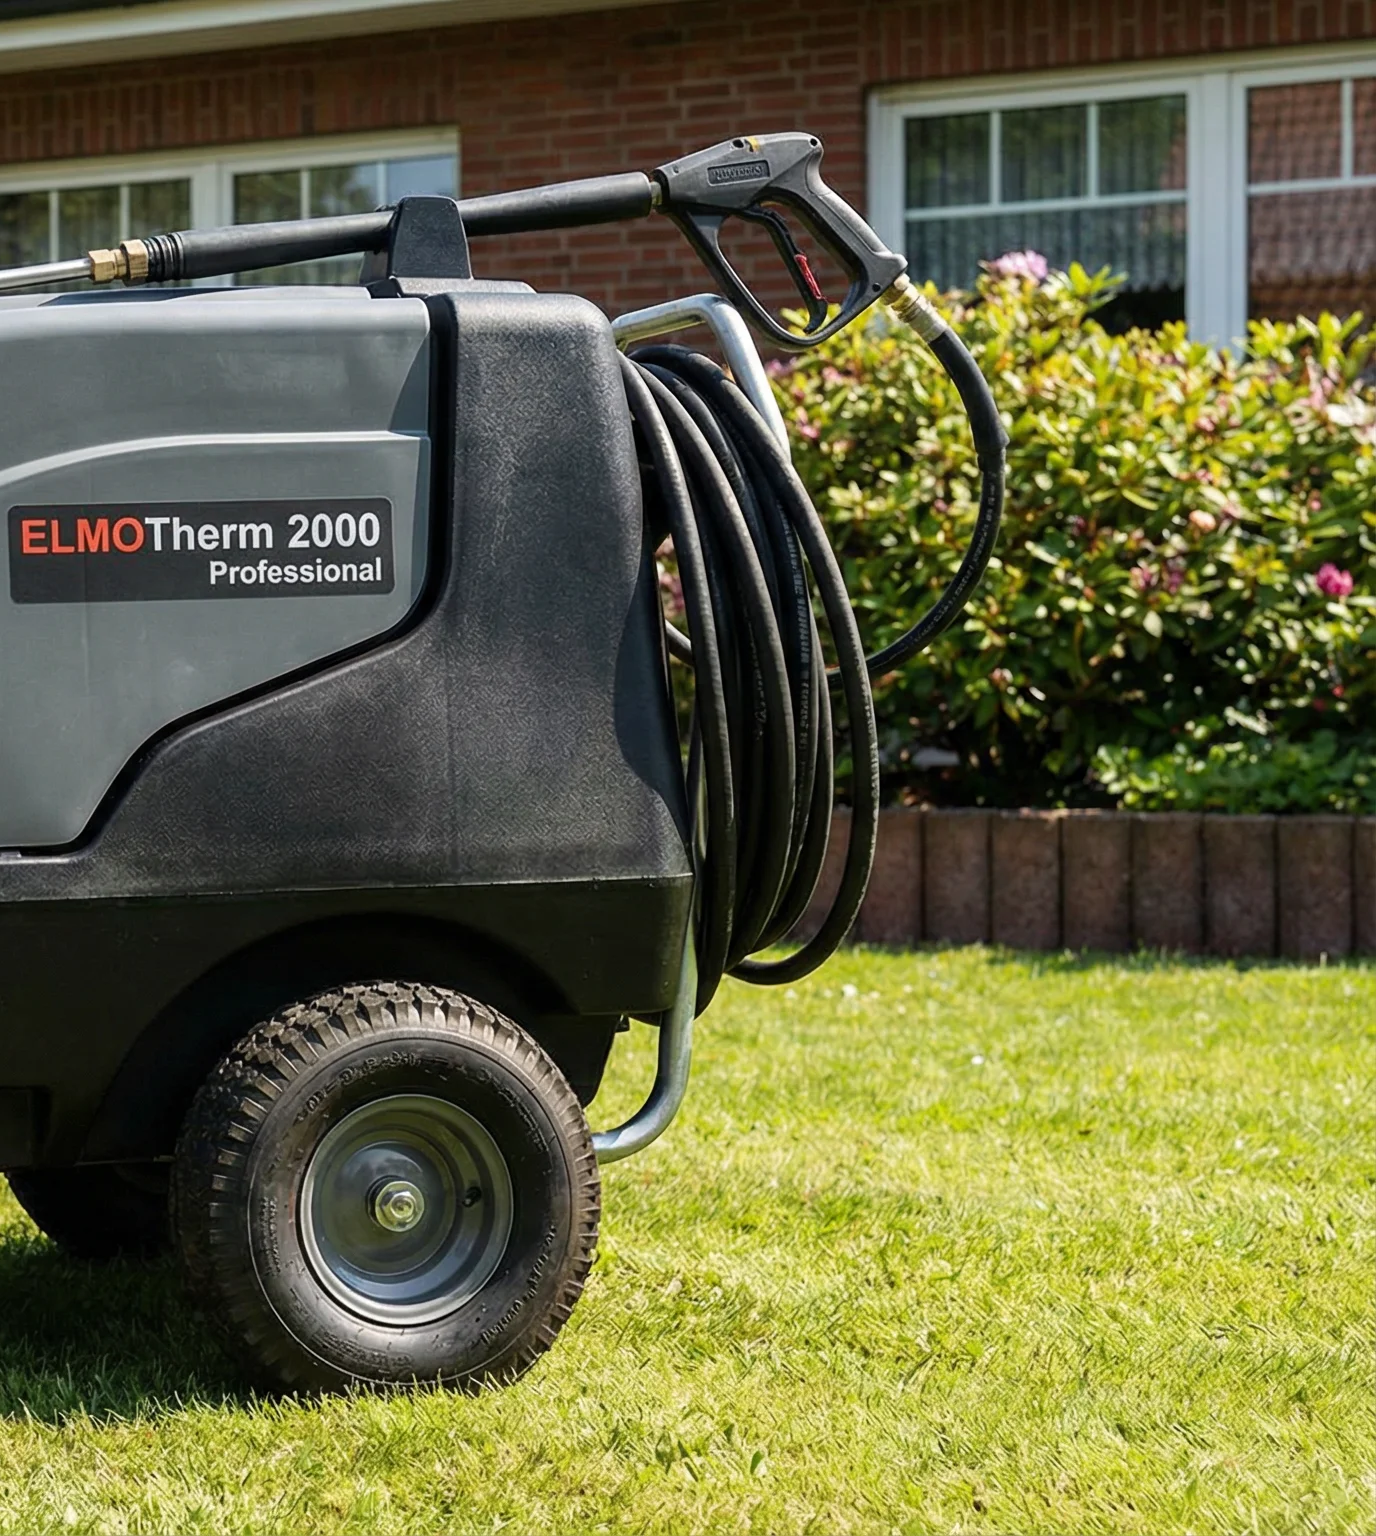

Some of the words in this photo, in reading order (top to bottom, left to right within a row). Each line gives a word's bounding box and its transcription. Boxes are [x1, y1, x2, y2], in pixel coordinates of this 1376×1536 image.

[21, 515, 274, 554] ELMOTherm
[288, 512, 381, 549] 2000
[209, 557, 383, 585] Professional
